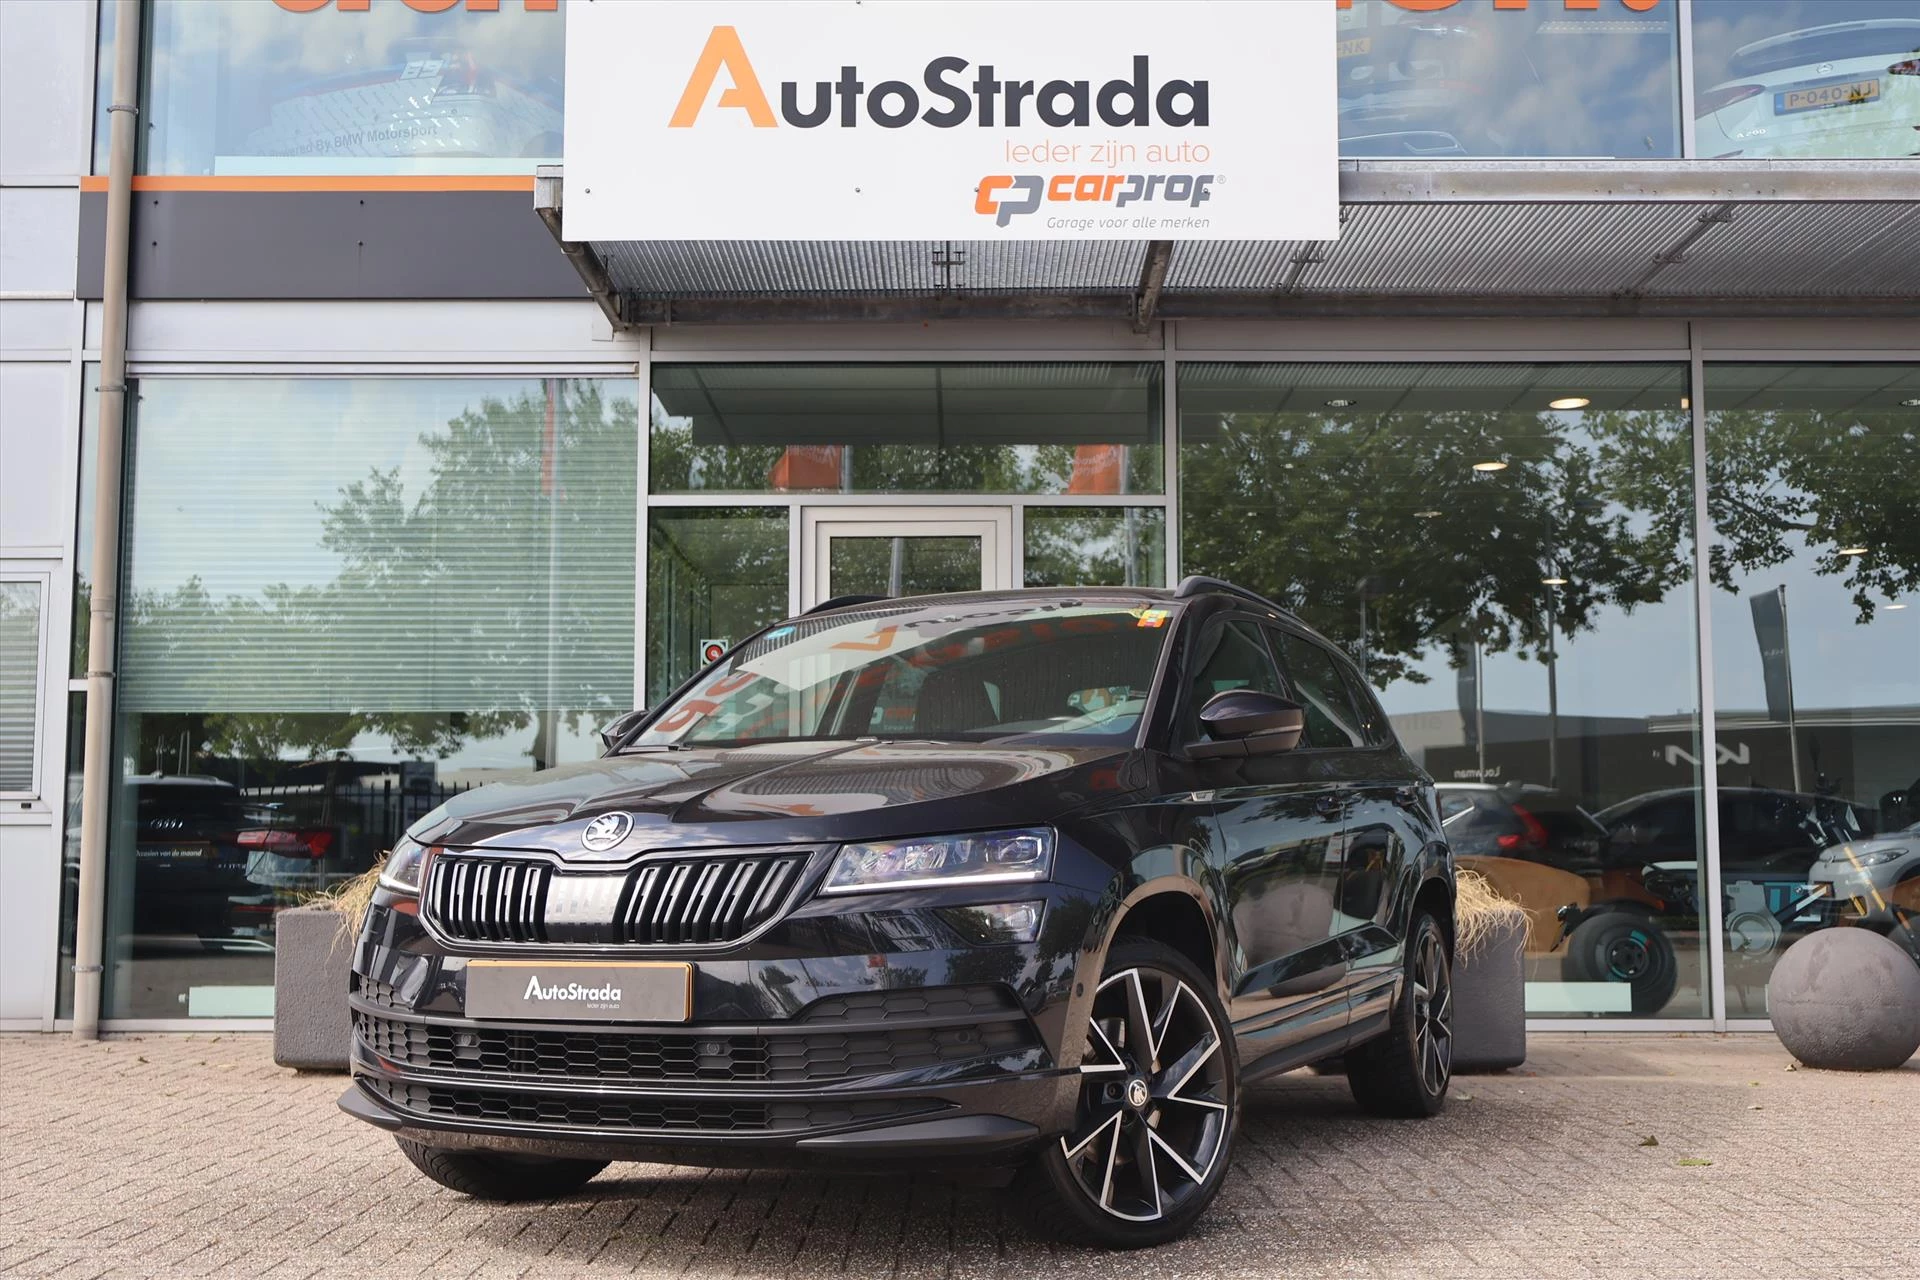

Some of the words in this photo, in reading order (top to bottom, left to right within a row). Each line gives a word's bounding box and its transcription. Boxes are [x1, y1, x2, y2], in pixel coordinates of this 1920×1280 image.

[667, 25, 1210, 129] AutoStrada
[1789, 82, 1873, 107] P-040-NJ
[316, 138, 331, 151] By
[334, 133, 364, 148] BMW
[367, 125, 438, 144] Motorsport
[1005, 139, 1082, 163] Ieder
[1090, 140, 1136, 169] zijn
[1146, 141, 1211, 163] auto
[1046, 216, 1095, 231] Garage
[1100, 218, 1127, 229] voor
[1132, 216, 1156, 229] alle
[1160, 216, 1210, 229] merken
[523, 975, 622, 1001] AutoStrada
